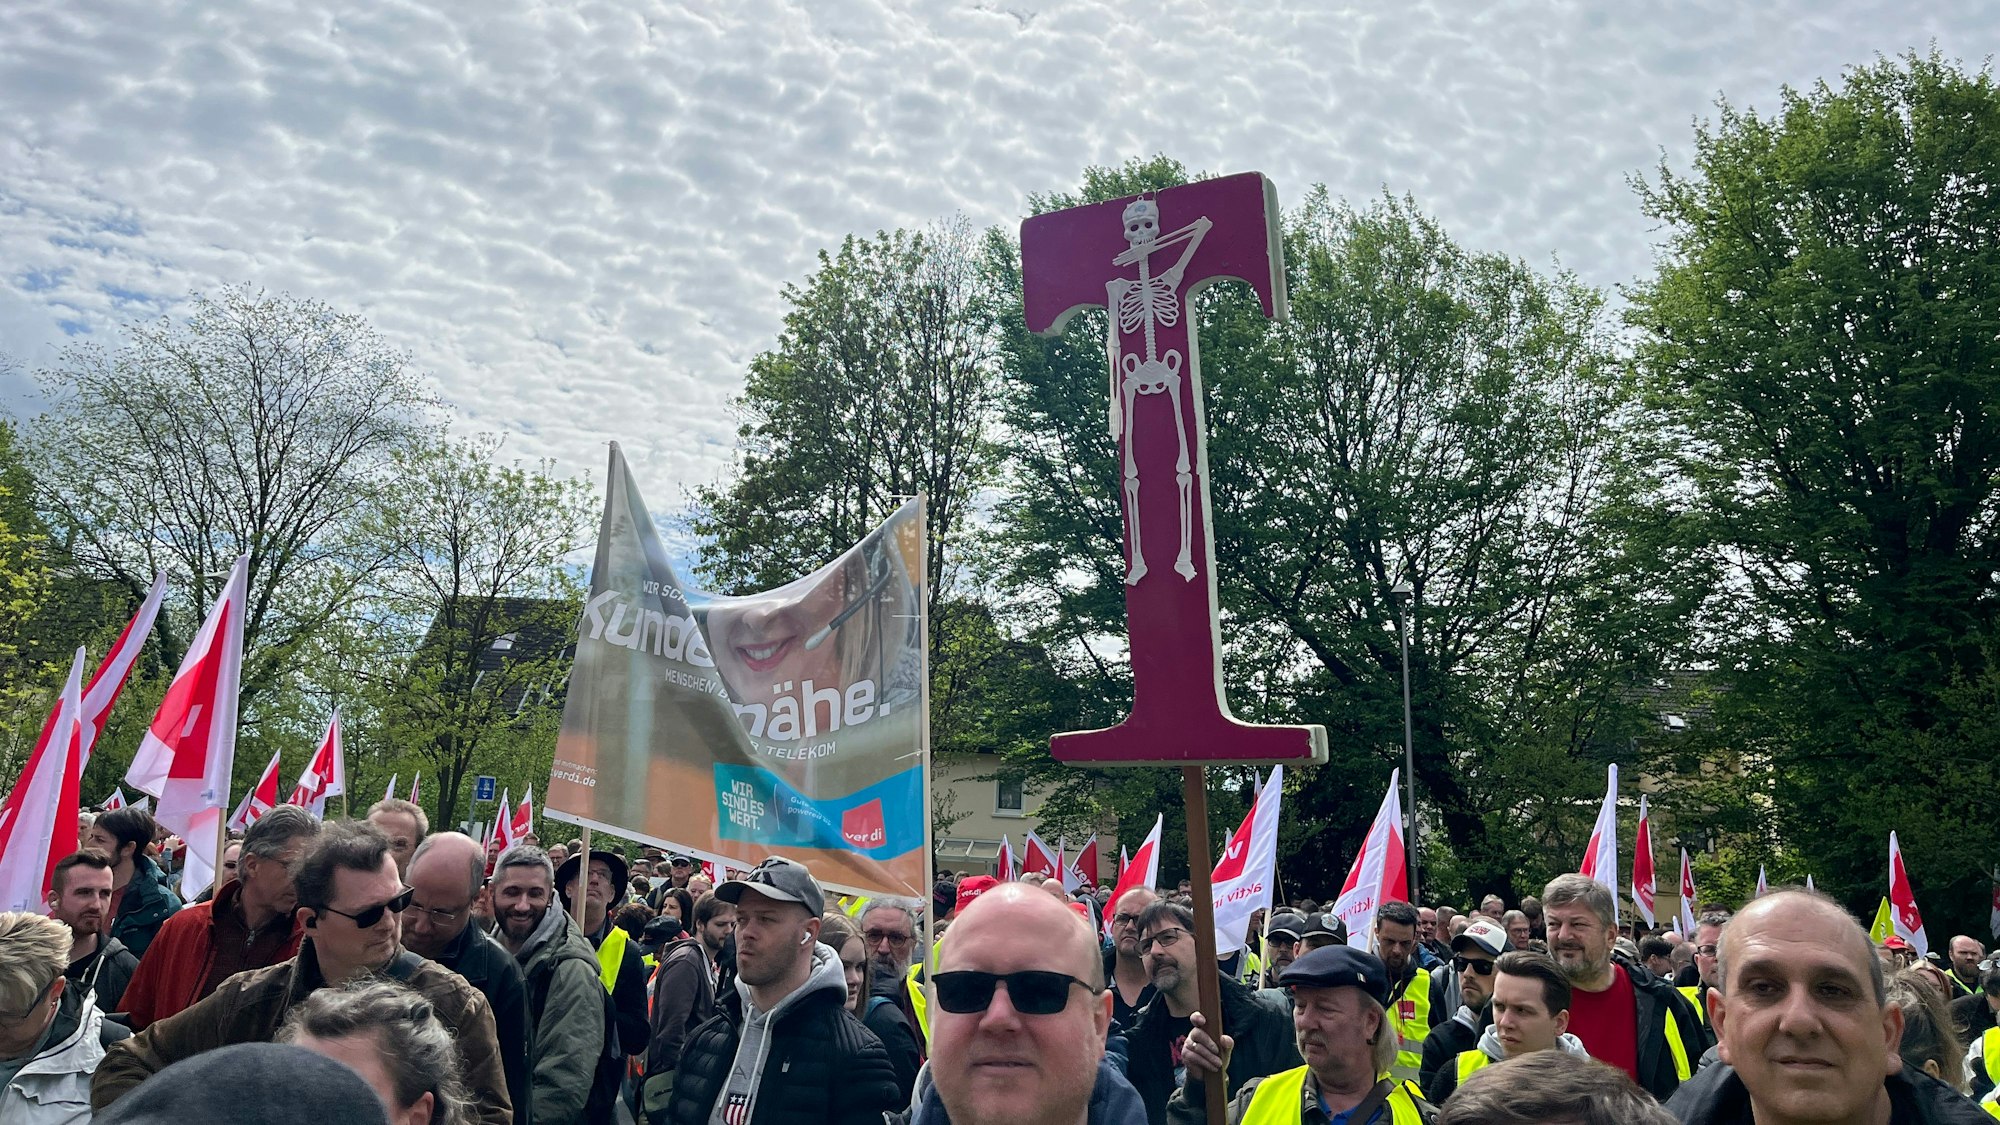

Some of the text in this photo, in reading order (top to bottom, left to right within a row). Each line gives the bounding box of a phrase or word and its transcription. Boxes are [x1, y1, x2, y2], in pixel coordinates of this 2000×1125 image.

[643, 580, 659, 596] WIR
[665, 668, 717, 694] MENSCHEN
[731, 679, 891, 741] nähe.
[766, 741, 836, 760] TELEKOM
[731, 779, 754, 799] WIR
[722, 791, 765, 817] SIND ES
[787, 806, 823, 820] powered
[728, 808, 761, 831] WERT.
